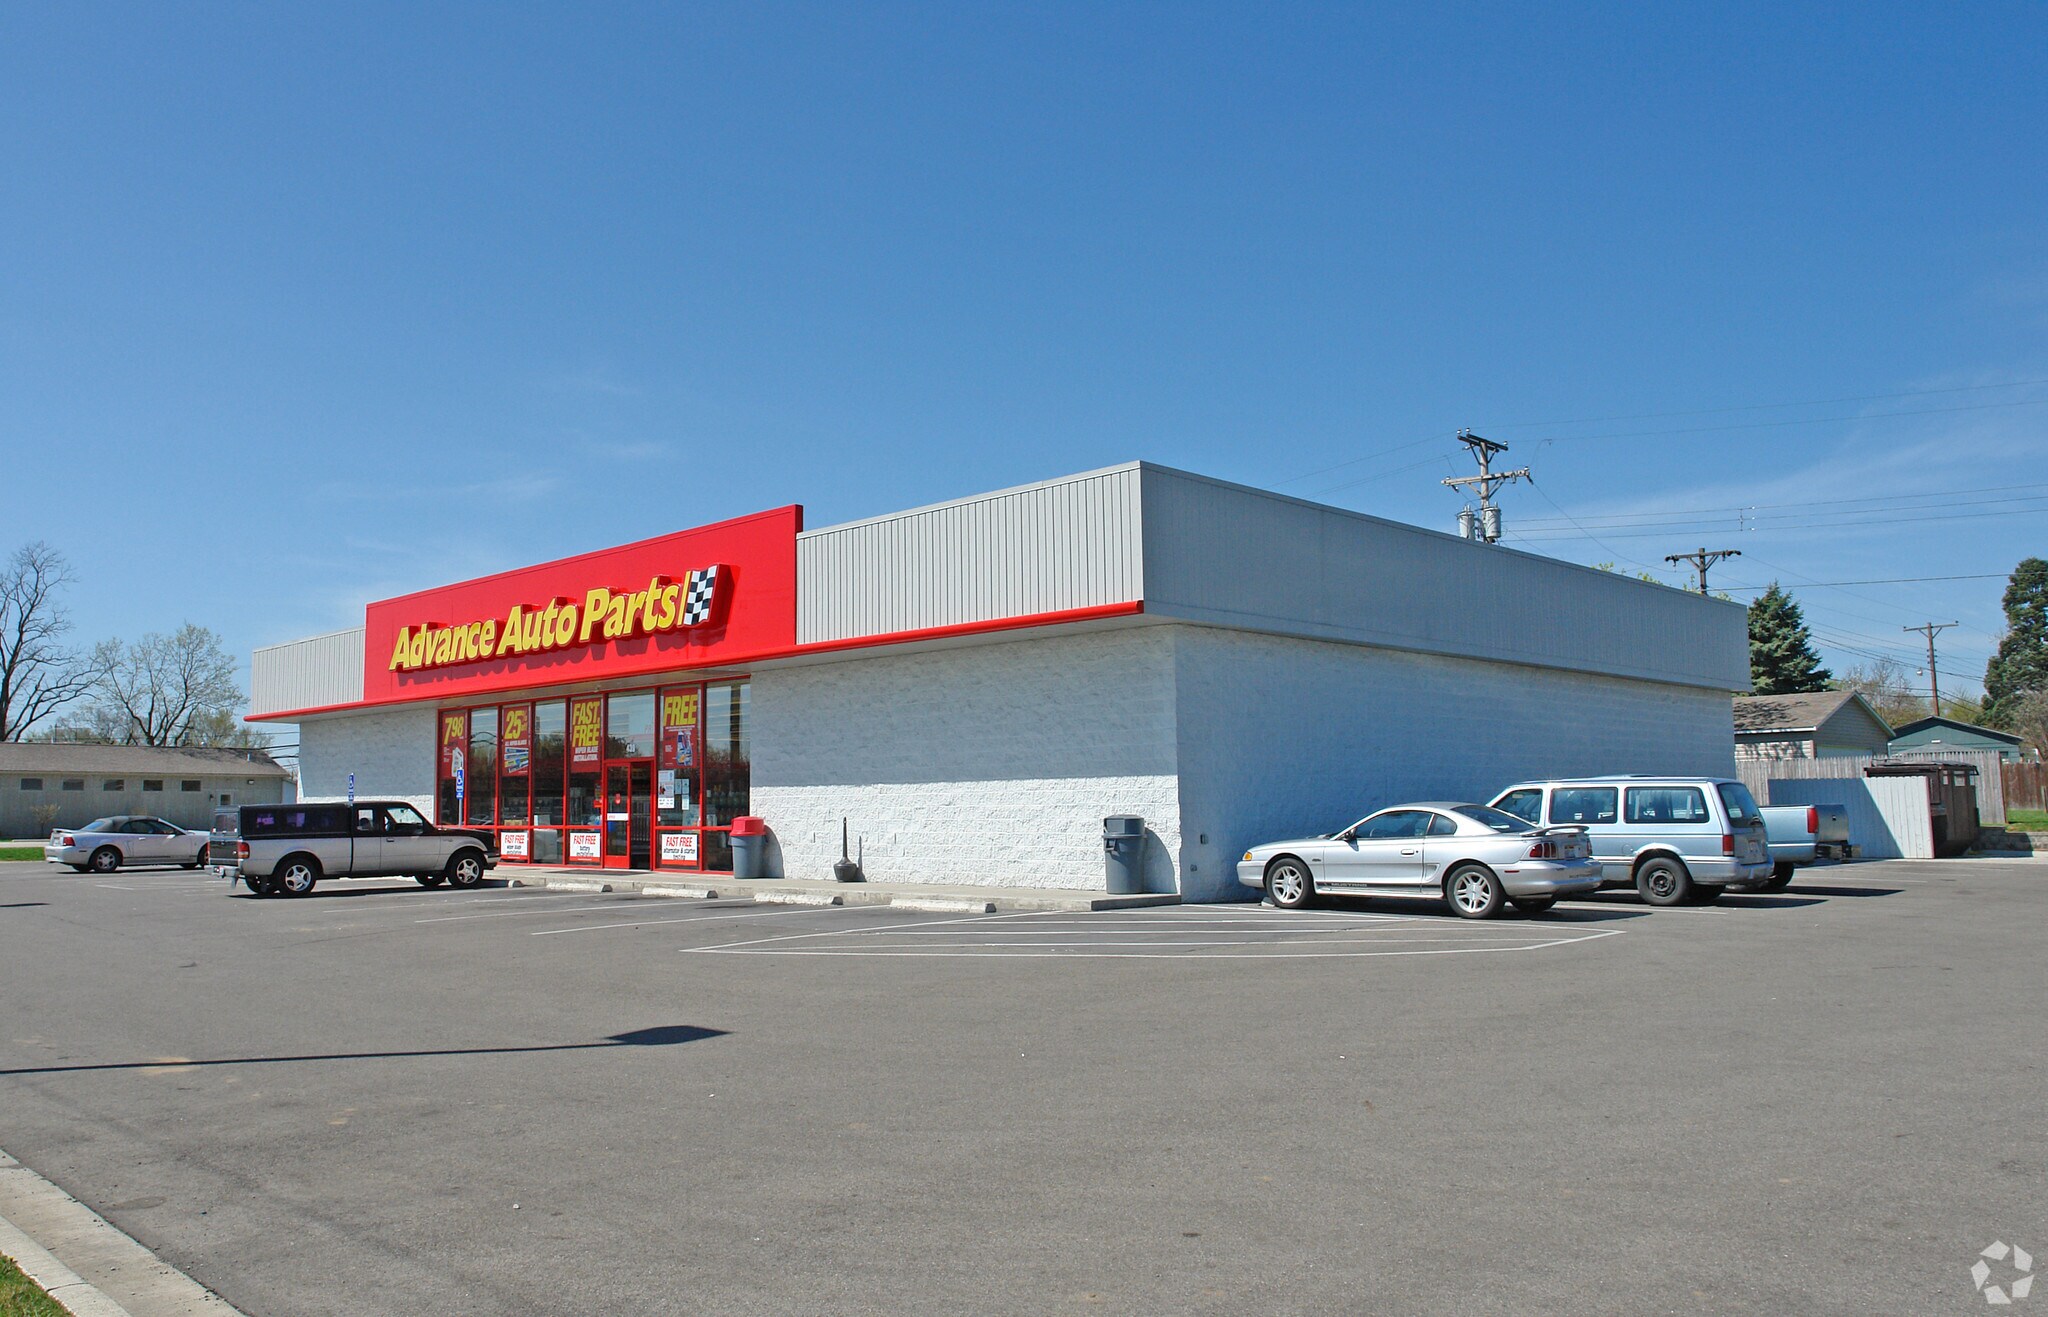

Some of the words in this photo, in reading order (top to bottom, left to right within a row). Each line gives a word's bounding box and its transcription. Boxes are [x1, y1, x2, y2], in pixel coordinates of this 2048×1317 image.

[388, 618, 496, 671] Advance
[496, 596, 577, 656] Auto
[579, 576, 681, 642] Parts
[664, 694, 698, 726] FREE
[572, 724, 600, 747] FREE
[505, 834, 514, 844] FAST
[515, 834, 525, 844] FREE
[574, 835, 584, 845] FAST
[585, 835, 596, 845] FREE
[666, 836, 679, 847] FAST
[679, 836, 693, 847] FREE
